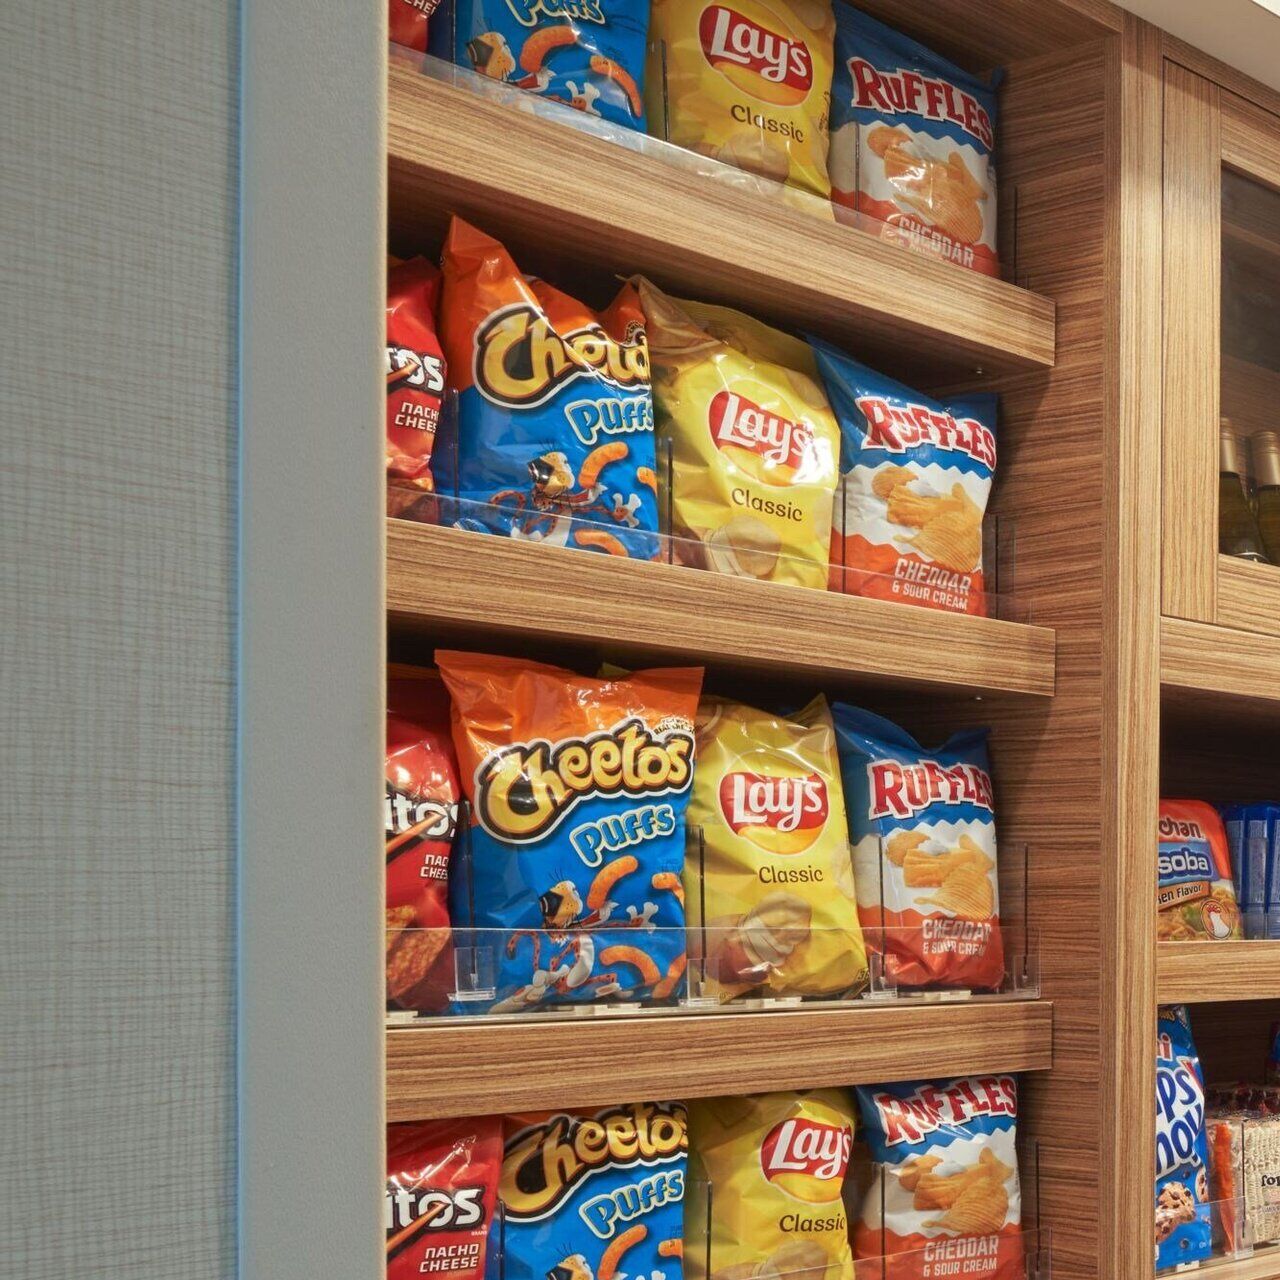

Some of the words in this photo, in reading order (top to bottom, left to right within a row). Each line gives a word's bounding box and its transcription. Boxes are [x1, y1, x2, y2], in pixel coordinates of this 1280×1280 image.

[711, 7, 808, 90] Lay's
[730, 104, 804, 143] Classic
[851, 56, 992, 150] RUFFLES
[900, 216, 974, 267] CHEDDAR
[401, 402, 439, 420] NACH
[718, 394, 812, 464] Lay's
[863, 398, 997, 471] RUFFLES
[732, 488, 803, 521] Classic
[892, 581, 900, 593] &
[903, 584, 930, 602] SOUR
[932, 589, 968, 611] CREAM
[894, 558, 971, 596] CHEDDAR
[486, 725, 690, 834] Cheetos
[733, 773, 822, 832] Lay's
[573, 806, 675, 862] Puffs
[758, 865, 824, 885] Classic
[876, 1077, 1017, 1144] RUFFLES
[769, 1121, 850, 1179] Lay's
[584, 1173, 683, 1233] Puffs
[779, 1214, 845, 1233] Classic
[420, 1257, 478, 1273] CHEESE
[425, 1243, 479, 1259] NACHO
[923, 1264, 930, 1277] &
[934, 1263, 960, 1277] SOUR
[962, 1257, 998, 1275] CREAM
[924, 1235, 999, 1262] CHEDDAR
